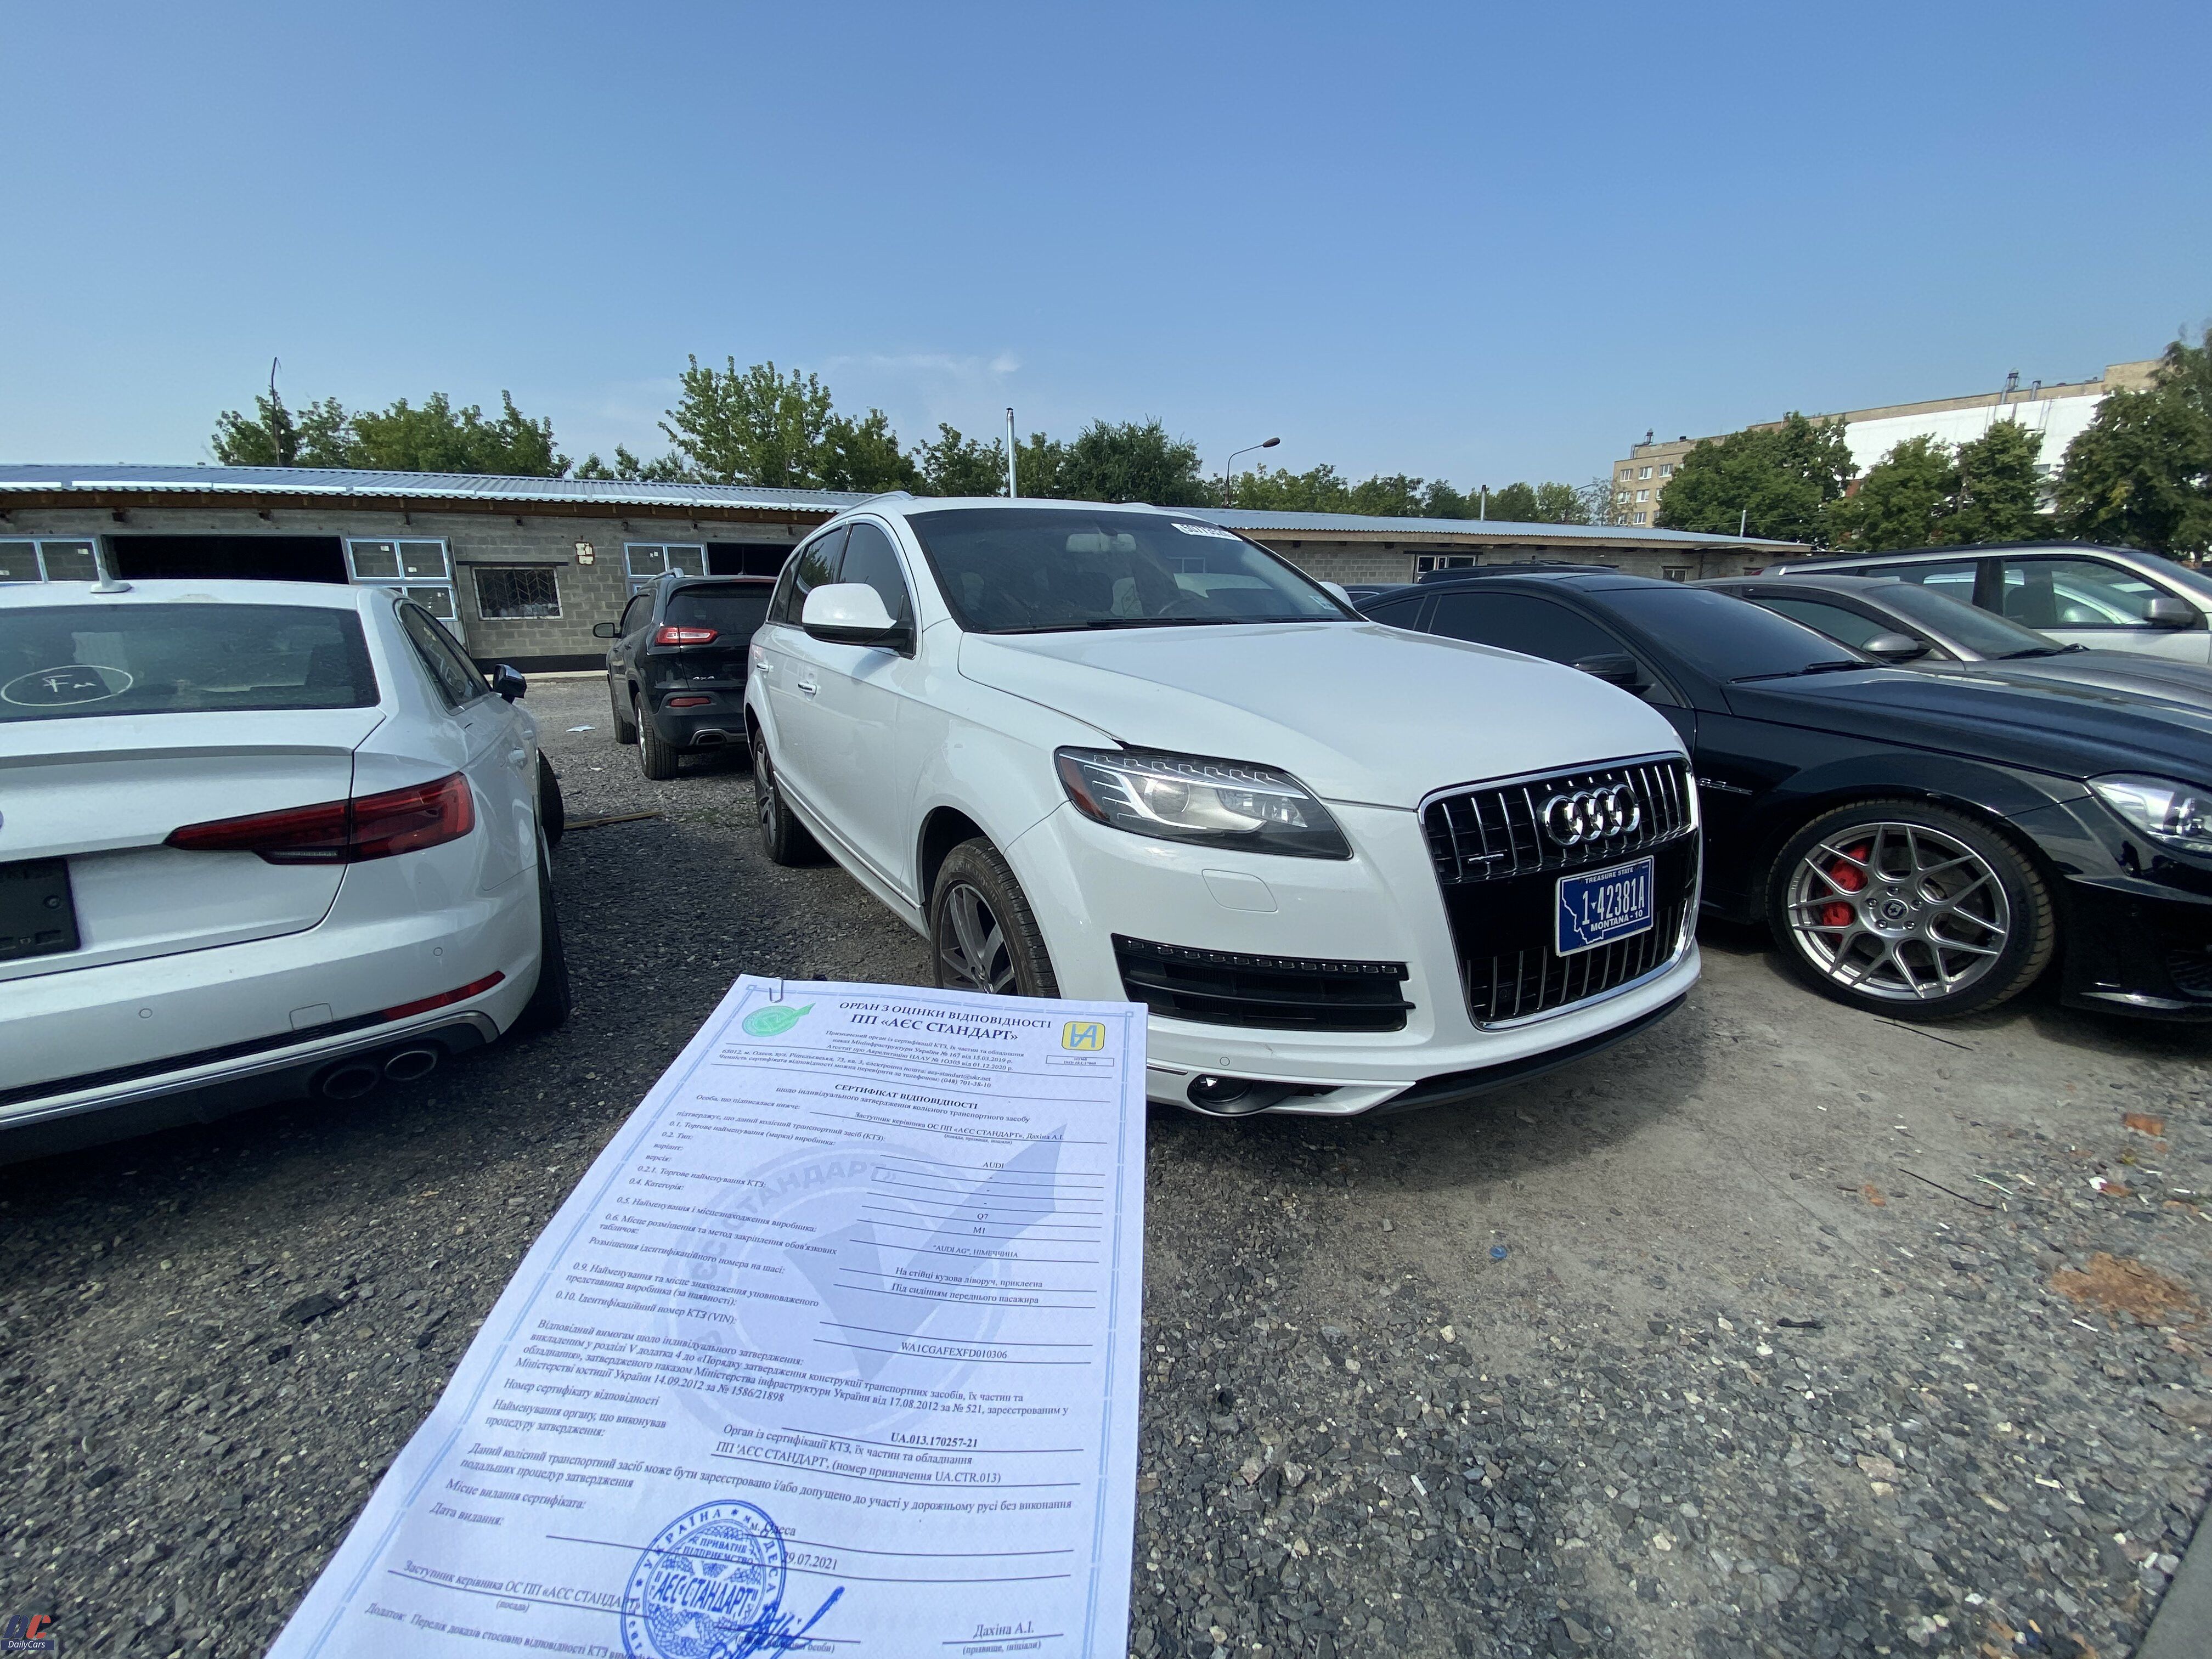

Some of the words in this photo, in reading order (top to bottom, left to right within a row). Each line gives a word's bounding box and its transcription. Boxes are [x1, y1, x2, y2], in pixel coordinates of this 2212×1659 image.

[1585, 871, 1616, 884] TREASURE
[1618, 867, 1634, 877] STATE
[1590, 913, 1629, 932] MONTANA
[839, 1002, 879, 1011] ОРГАН
[891, 1007, 945, 1018] ОЦІНКИ
[948, 1011, 1051, 1028] ВІДПОВІДНОСТІ
[850, 1014, 877, 1025] ПП
[881, 1018, 922, 1030] «АЄС
[926, 1022, 1018, 1041] СТАНДАРТ»
[835, 1084, 899, 1098] СЕРТИФІКАТ
[900, 1093, 978, 1109] ВІДПОВІДНОСТІ
[892, 1284, 907, 1294] Під
[909, 1286, 948, 1297] сидінням
[949, 1289, 997, 1301] переднього
[998, 1296, 1040, 1306] пасажира
[724, 1425, 757, 1438] Орган
[766, 1433, 828, 1449] сертифікації
[828, 1441, 851, 1454] КТЗ,
[867, 1448, 900, 1461] частин
[915, 1453, 972, 1464] обладнання
[890, 1432, 977, 1448] UA.013.170257-21
[467, 1443, 503, 1456] Даний
[503, 1449, 546, 1462] колісний
[548, 1454, 616, 1469] транспортний
[617, 1462, 642, 1471] засіб
[644, 1465, 672, 1476] може
[699, 1472, 771, 1488] зареєстровано
[773, 1481, 798, 1493] і/або
[799, 1487, 851, 1502] допущено
[867, 1497, 901, 1508] участі
[911, 1502, 974, 1513] дорожньому
[1019, 1500, 1071, 1510] виконання
